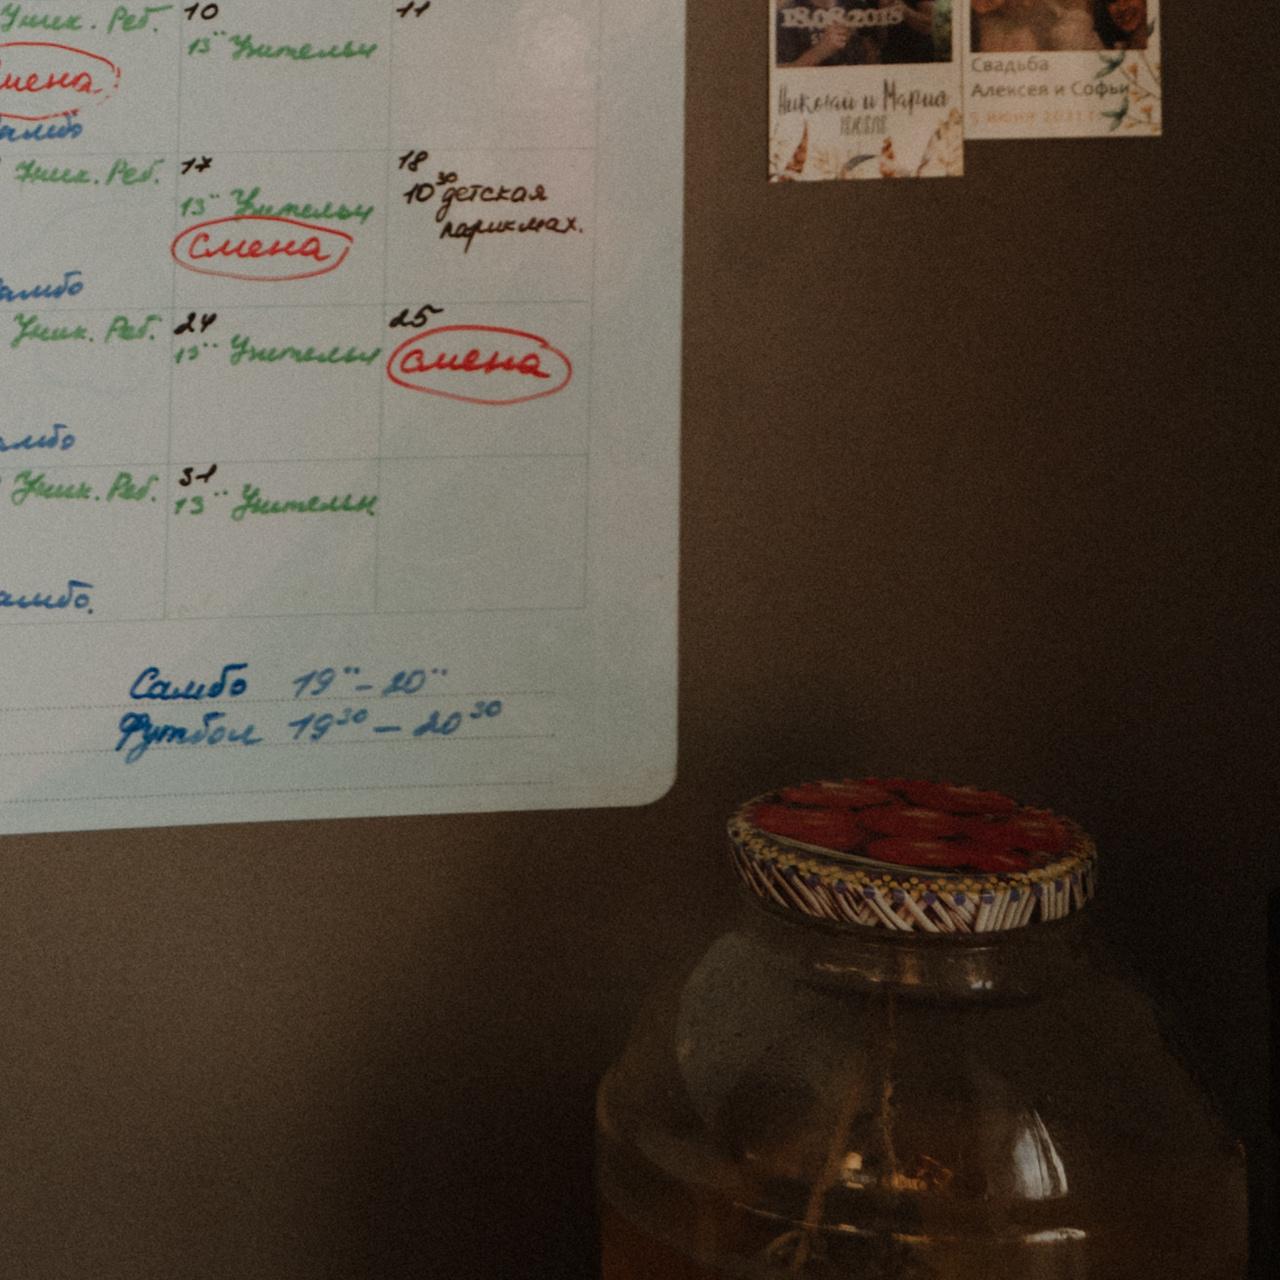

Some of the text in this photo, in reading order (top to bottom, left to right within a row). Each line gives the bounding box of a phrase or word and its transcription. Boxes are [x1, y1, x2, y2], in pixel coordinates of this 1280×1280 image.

[183, 3, 220, 22] 10
[396, 1, 431, 20] 11
[971, 56, 1050, 75] Свадьба
[971, 81, 1130, 99] Алексея и Софьи
[181, 156, 214, 176] 17
[398, 151, 428, 172] 18
[189, 229, 333, 263] Смена
[174, 312, 217, 336] 24
[389, 304, 443, 329] 25
